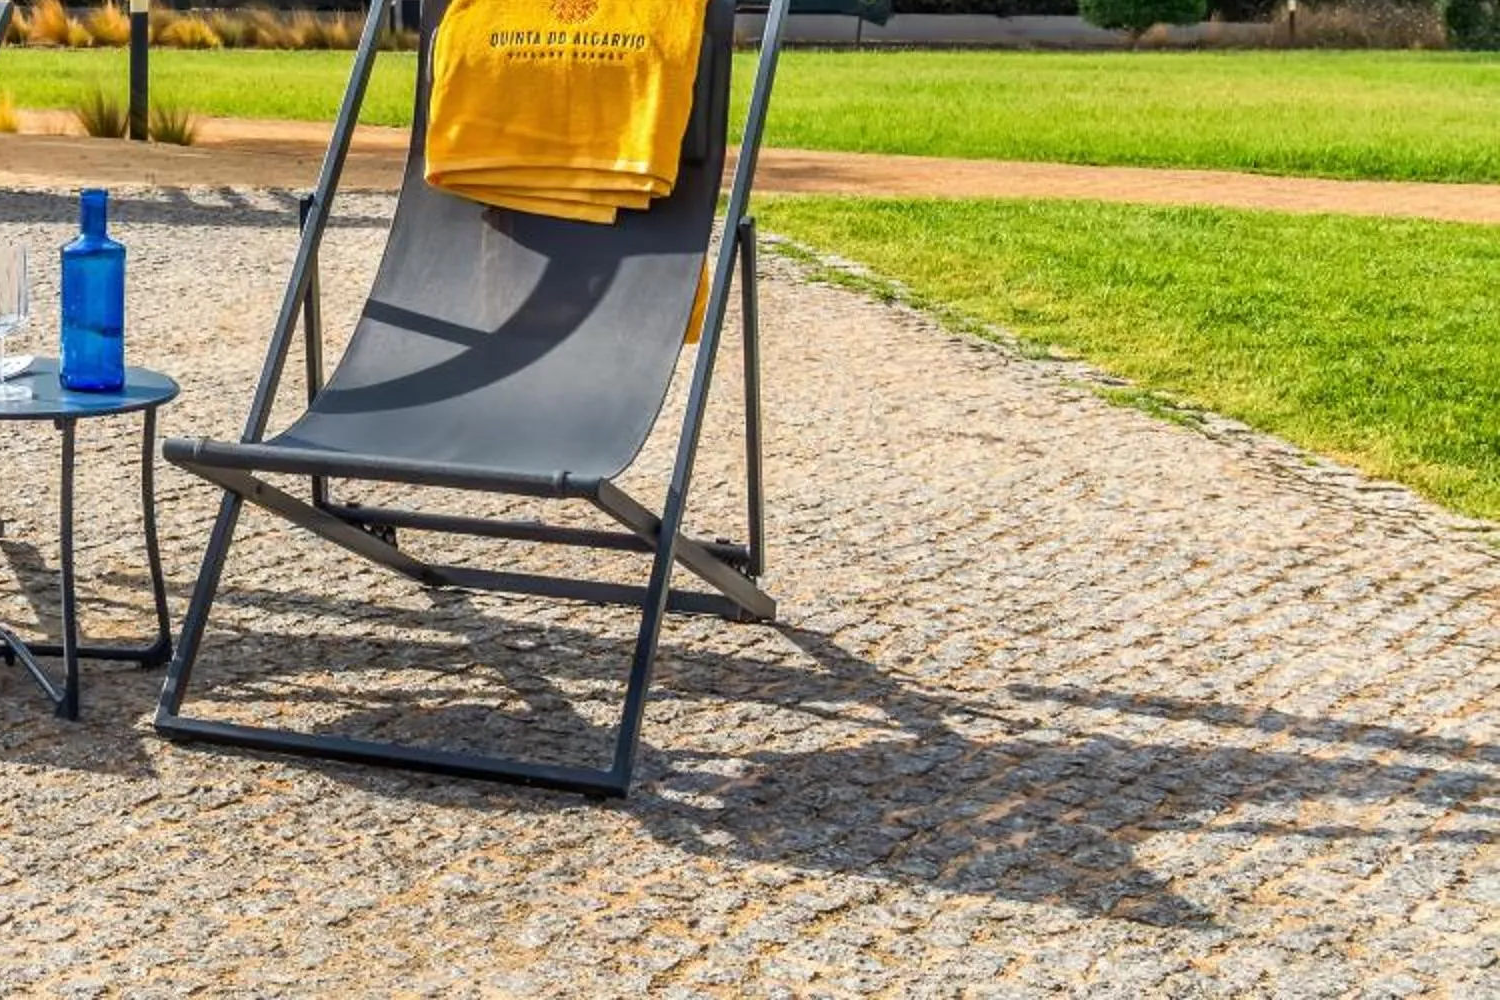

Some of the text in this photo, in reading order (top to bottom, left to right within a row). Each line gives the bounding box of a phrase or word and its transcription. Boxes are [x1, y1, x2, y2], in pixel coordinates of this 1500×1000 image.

[490, 31, 645, 49] QUINTA DO ALGARVIO
